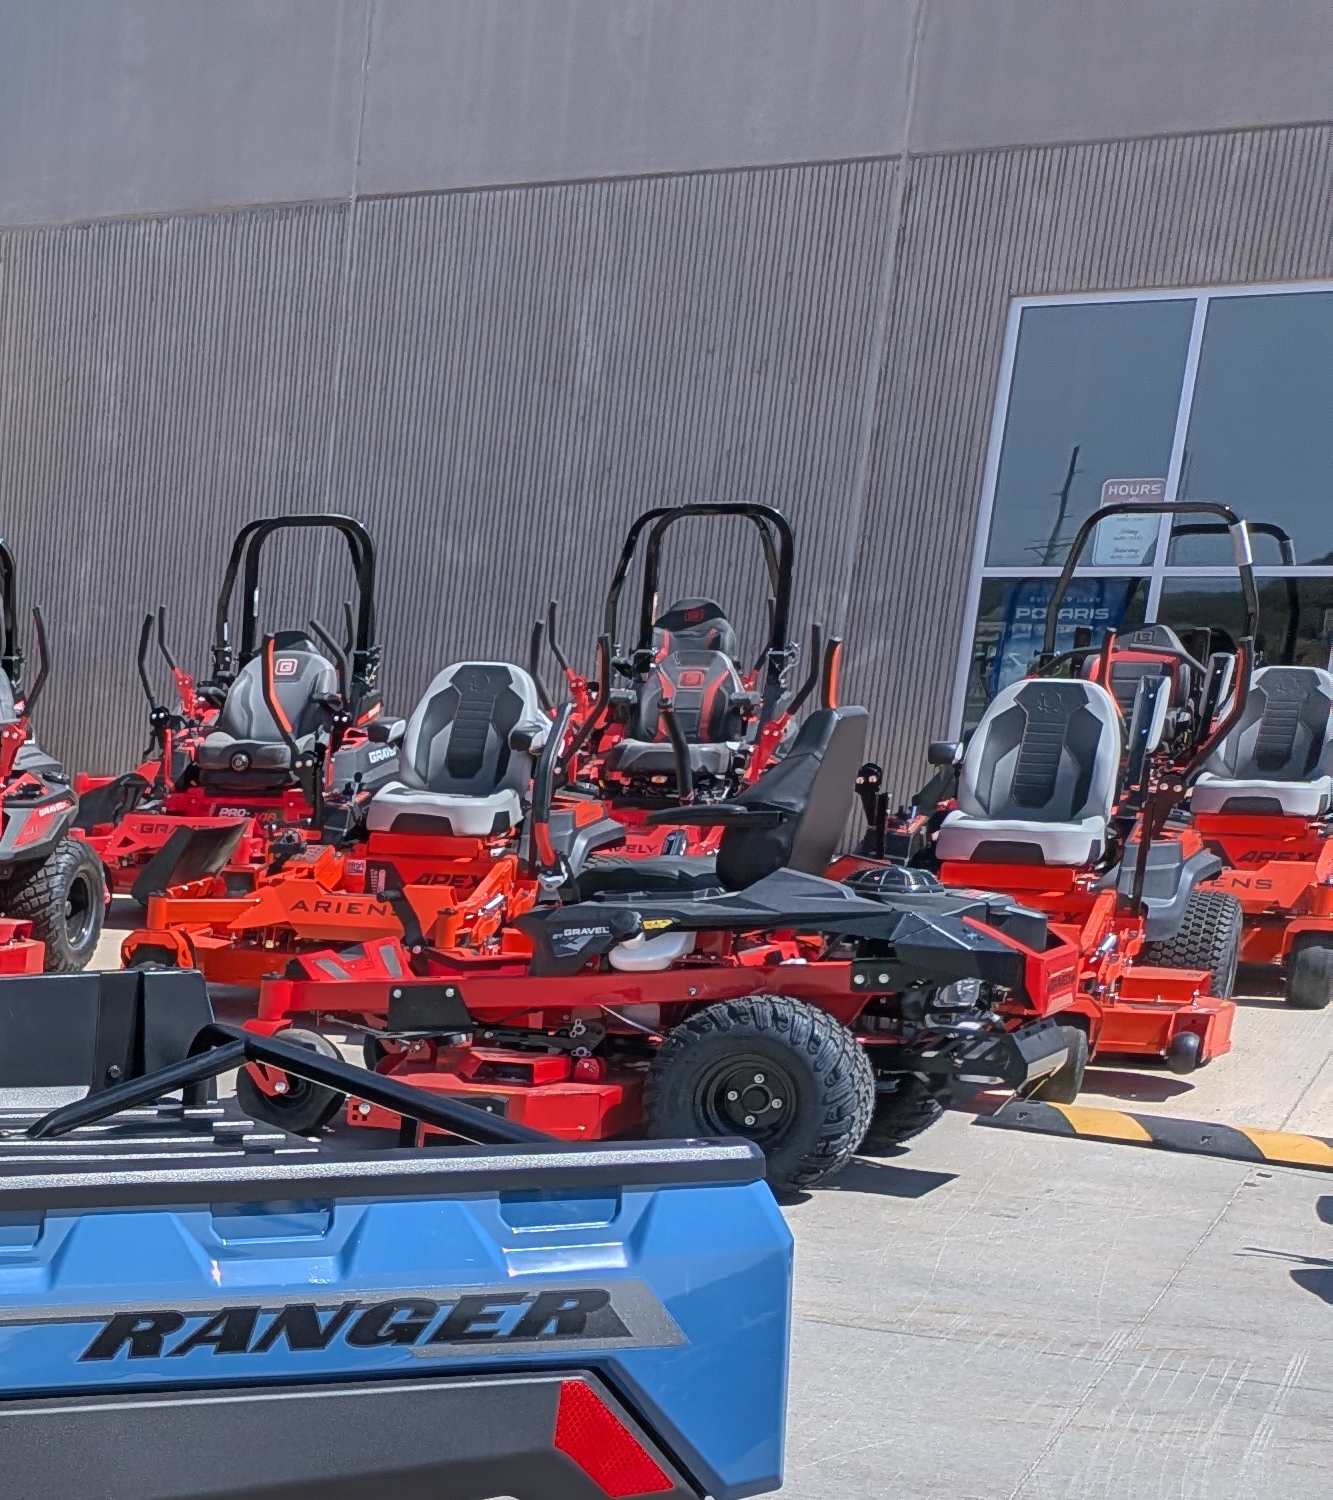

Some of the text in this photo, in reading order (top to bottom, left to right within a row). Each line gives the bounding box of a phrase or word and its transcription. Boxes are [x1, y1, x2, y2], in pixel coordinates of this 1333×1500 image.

[1108, 484, 1162, 495] HOURS
[1015, 608, 1109, 619] POARIS
[1238, 850, 1313, 863] APEX
[412, 873, 483, 889] APEX
[564, 926, 609, 937] GRAVEL
[77, 1289, 633, 1363] RANGER
